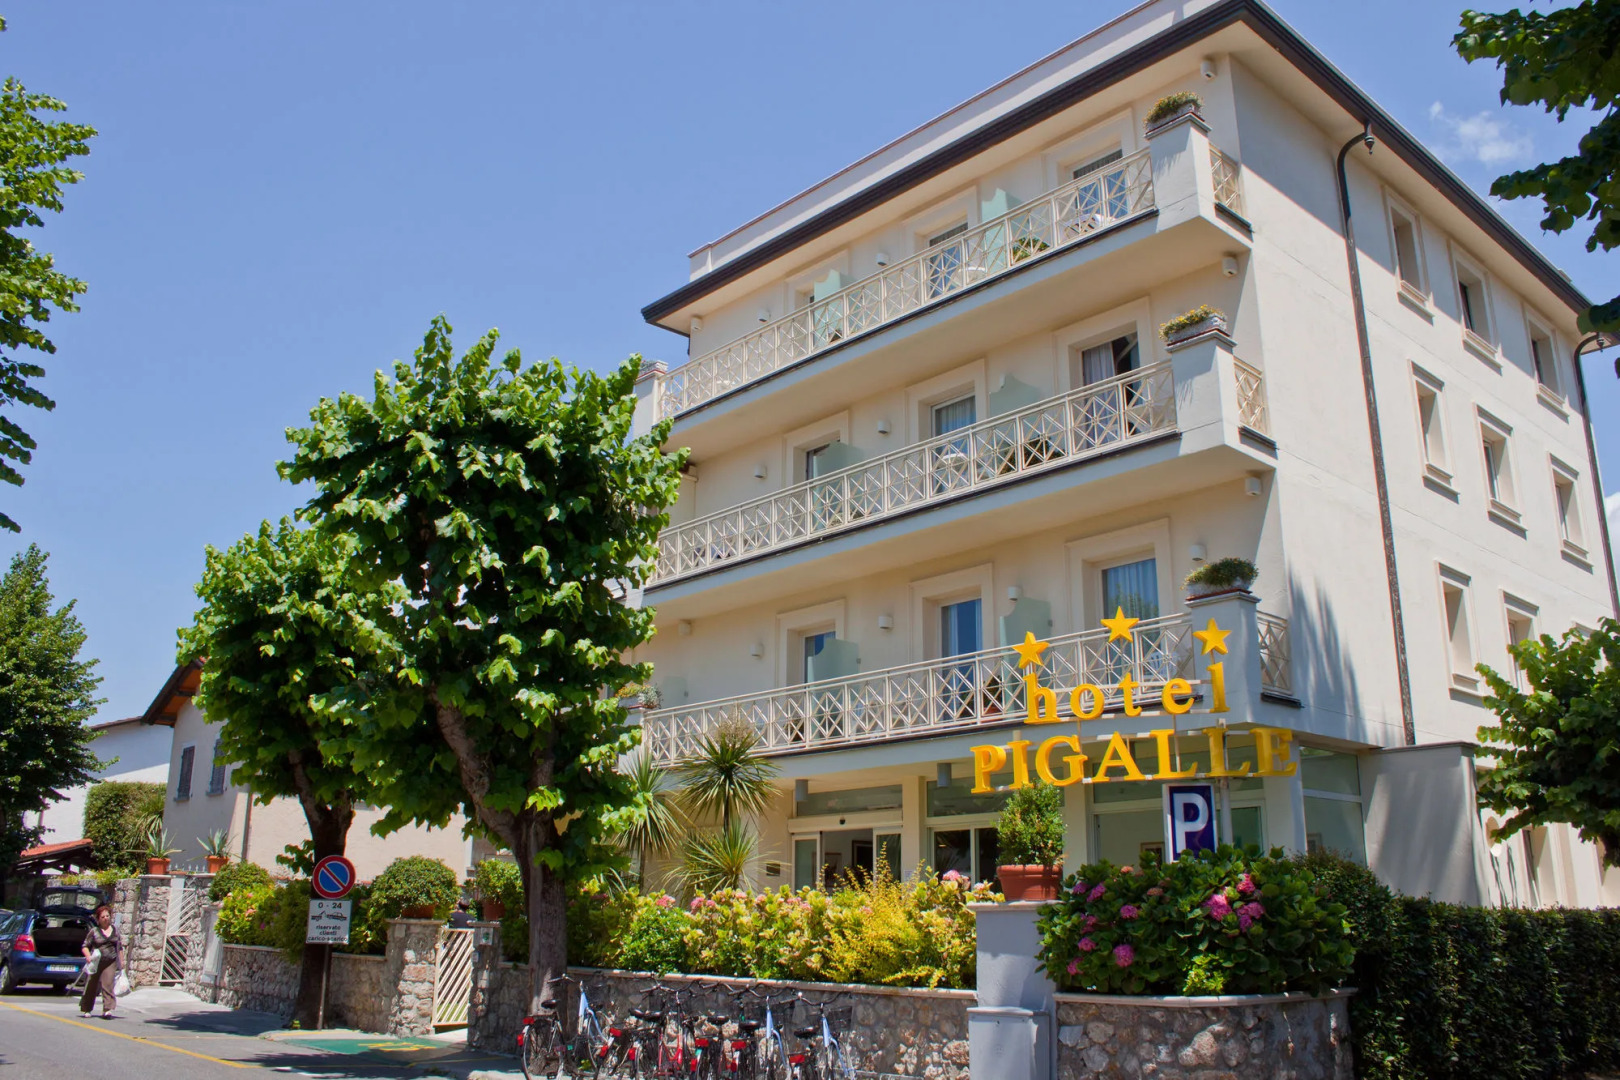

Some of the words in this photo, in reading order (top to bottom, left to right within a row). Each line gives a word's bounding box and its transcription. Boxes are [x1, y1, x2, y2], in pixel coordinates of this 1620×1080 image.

[1024, 662, 1230, 724] hotel
[970, 729, 1297, 793] PIGALLE
[1173, 793, 1209, 855] P
